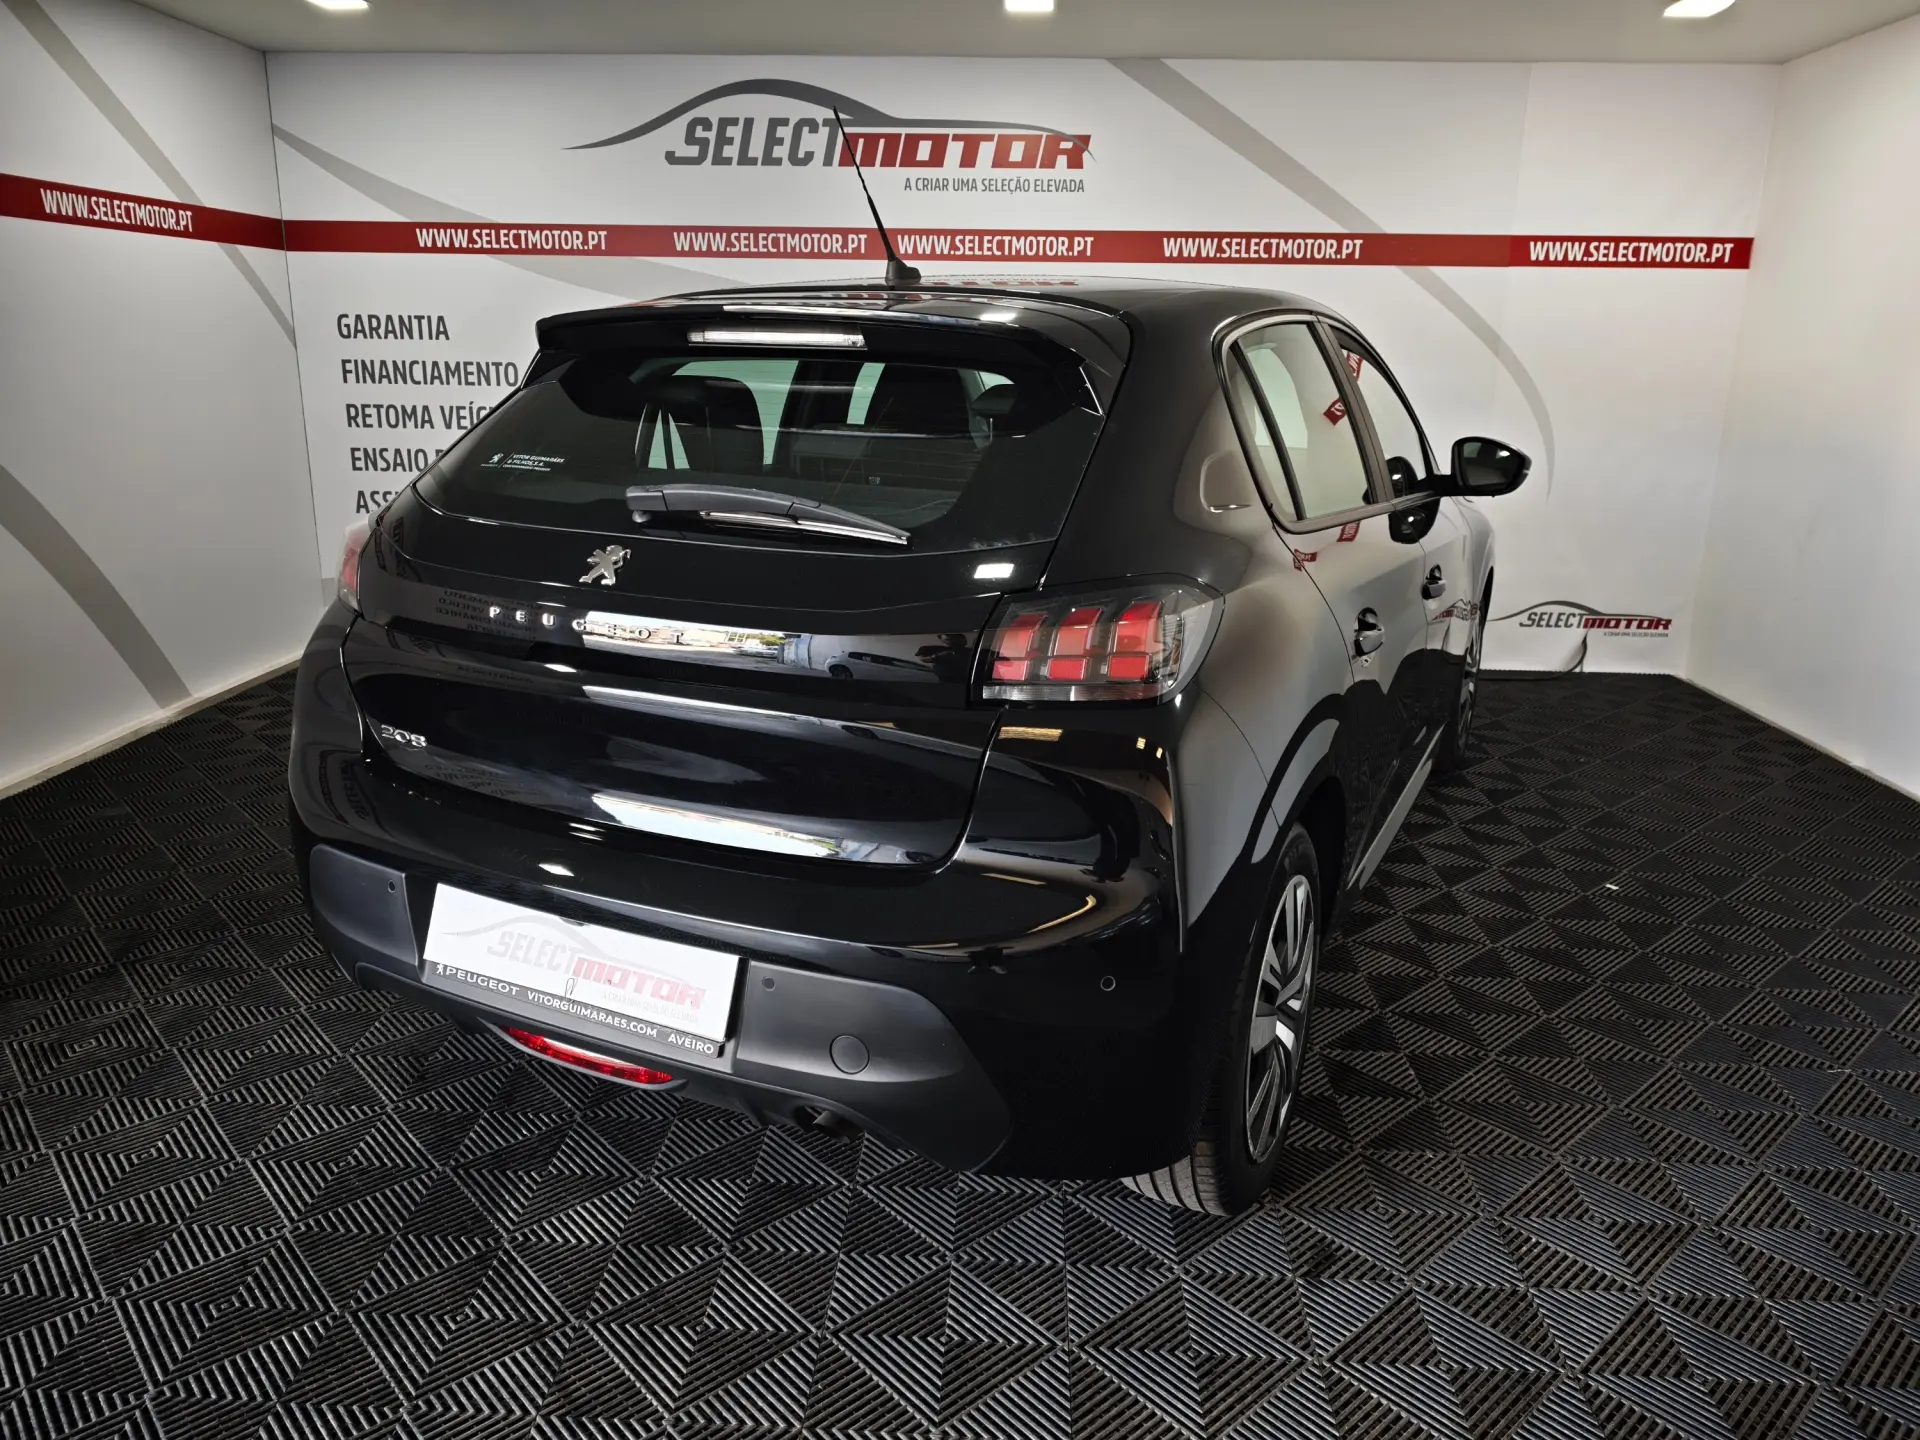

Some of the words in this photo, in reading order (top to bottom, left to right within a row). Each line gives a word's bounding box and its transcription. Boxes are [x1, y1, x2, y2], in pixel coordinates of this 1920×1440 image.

[904, 177, 912, 191] A
[915, 177, 949, 192] CRIAR
[952, 178, 978, 192] UMA
[981, 176, 1031, 194] SELEÇÃO
[1034, 178, 1085, 193] ELEVADA
[40, 188, 193, 232] WWW.SELECTMOTOR.PT
[415, 228, 607, 250] WWW.SELECTMOTOR.PT
[674, 231, 868, 254] WWW.SELECTMOTOR.PT
[898, 234, 1094, 257] WWW.SELECTMOTOR.PT
[1163, 237, 1363, 260] WWW.SELECTMOTOR.PT
[1529, 241, 1734, 263] WWW.SELECTMOTOR.PT
[337, 313, 450, 341] GARANTIA
[341, 359, 519, 387] FINANCIAMENTO
[345, 403, 435, 430] RETOMA
[439, 400, 494, 430] VEÍC
[350, 447, 428, 472] ENSAIO
[489, 605, 684, 644] PEUGEOT
[1519, 611, 1672, 631] SELECTMOTOR
[381, 724, 427, 747] 208
[446, 965, 520, 995] PEUGEOT
[527, 990, 658, 1038] VITORGUIMARAES.COM
[667, 1032, 714, 1055] AVEIRO
